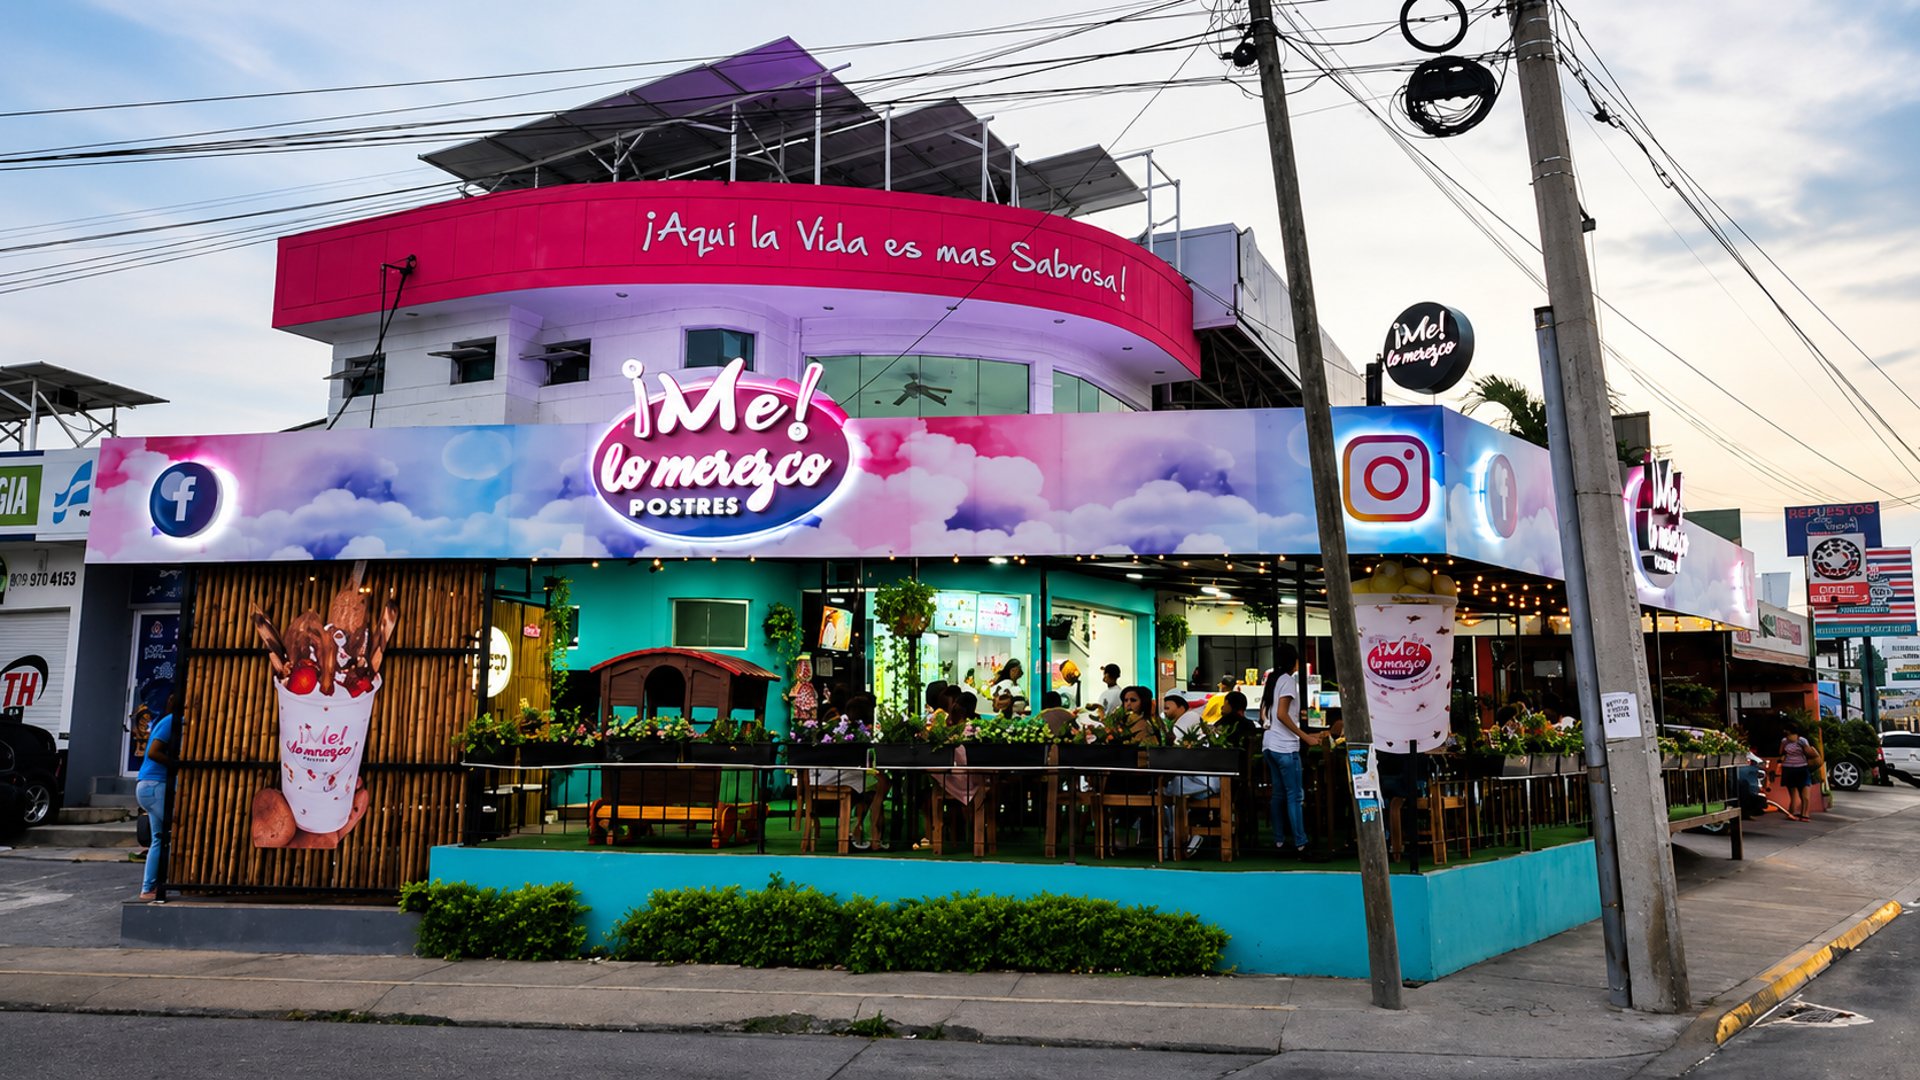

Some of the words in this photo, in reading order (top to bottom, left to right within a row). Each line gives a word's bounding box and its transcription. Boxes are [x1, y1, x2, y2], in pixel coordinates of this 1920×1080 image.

[642, 211, 735, 257] ¡Aquí
[752, 214, 779, 250] la
[797, 216, 868, 256] Vida
[884, 238, 922, 259] es
[936, 244, 996, 267] mas
[1010, 241, 1127, 302] Sabrosa!
[1393, 310, 1445, 350] ¡Me!
[1387, 349, 1401, 368] lo
[1401, 341, 1456, 367] merezco
[621, 357, 824, 442] ¡Me!
[600, 442, 651, 493] lo
[651, 447, 833, 513] merezco
[629, 496, 739, 517] POSTRES
[1788, 504, 1876, 519] REPUESTOS
[29, 572, 48, 587] 970
[50, 571, 77, 587] 4153
[3, 672, 39, 707] TH
